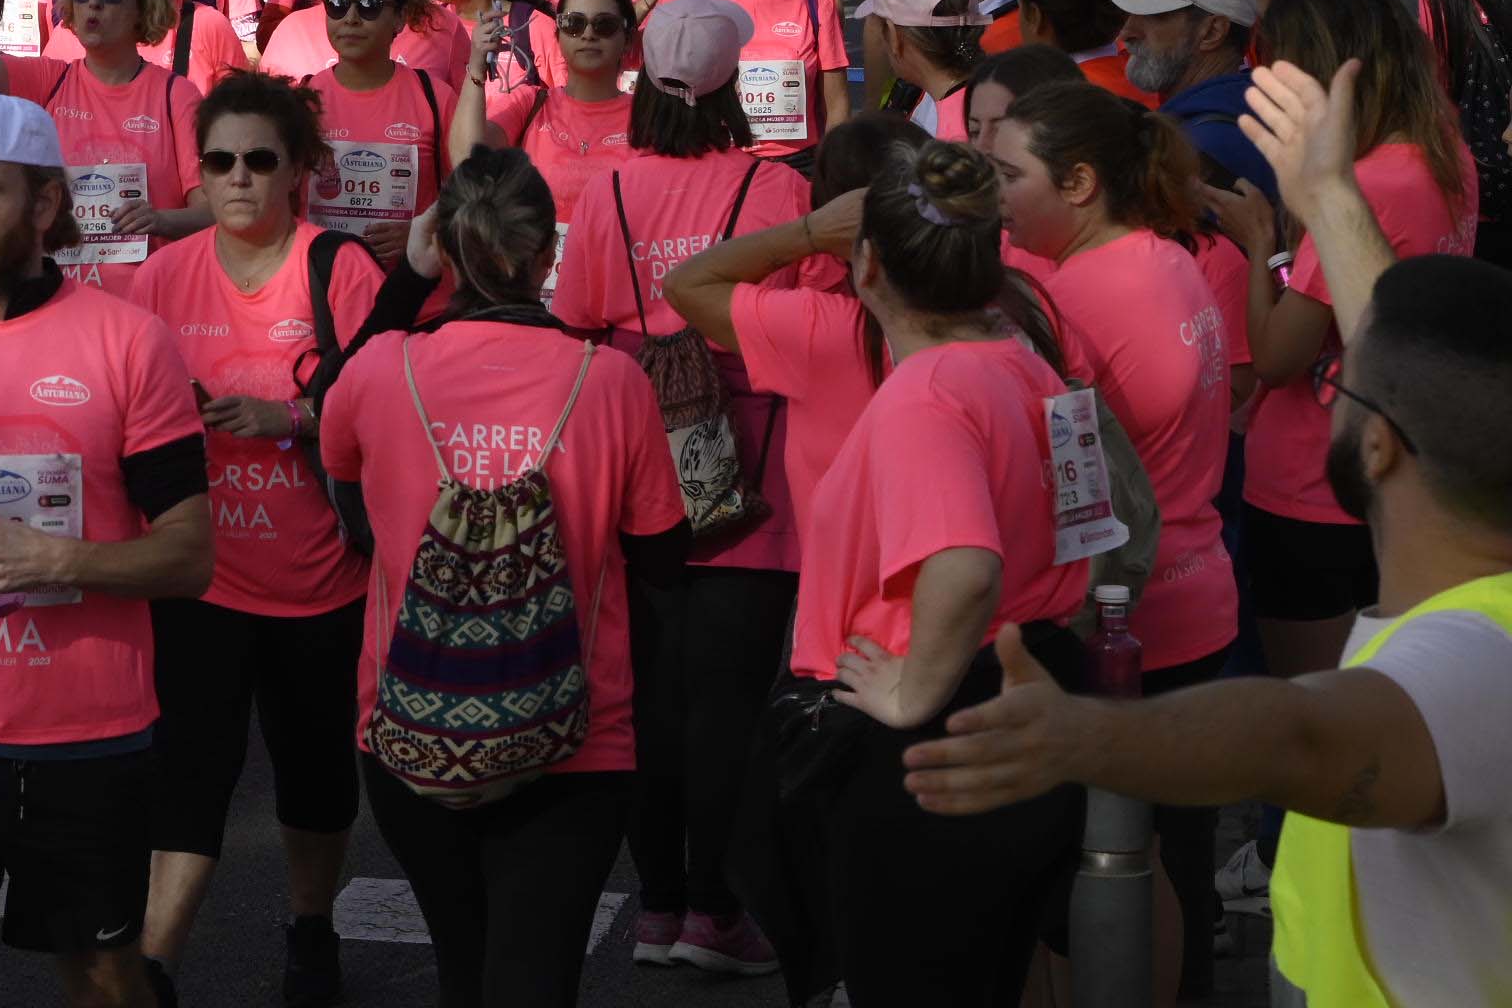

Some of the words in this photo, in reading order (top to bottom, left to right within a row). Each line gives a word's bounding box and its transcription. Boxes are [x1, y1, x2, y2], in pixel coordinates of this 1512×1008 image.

[343, 157, 385, 169] ASTURIANA
[345, 179, 381, 194] 016
[349, 197, 374, 207] 6872
[107, 247, 141, 257] Santander
[180, 322, 231, 337] OYSHO
[34, 386, 88, 401] ASTURIANA
[428, 421, 566, 454] CARRERA
[453, 449, 491, 475] DE
[503, 451, 536, 476] LA
[37, 474, 71, 485] SUMA
[28, 656, 52, 667] 2023
